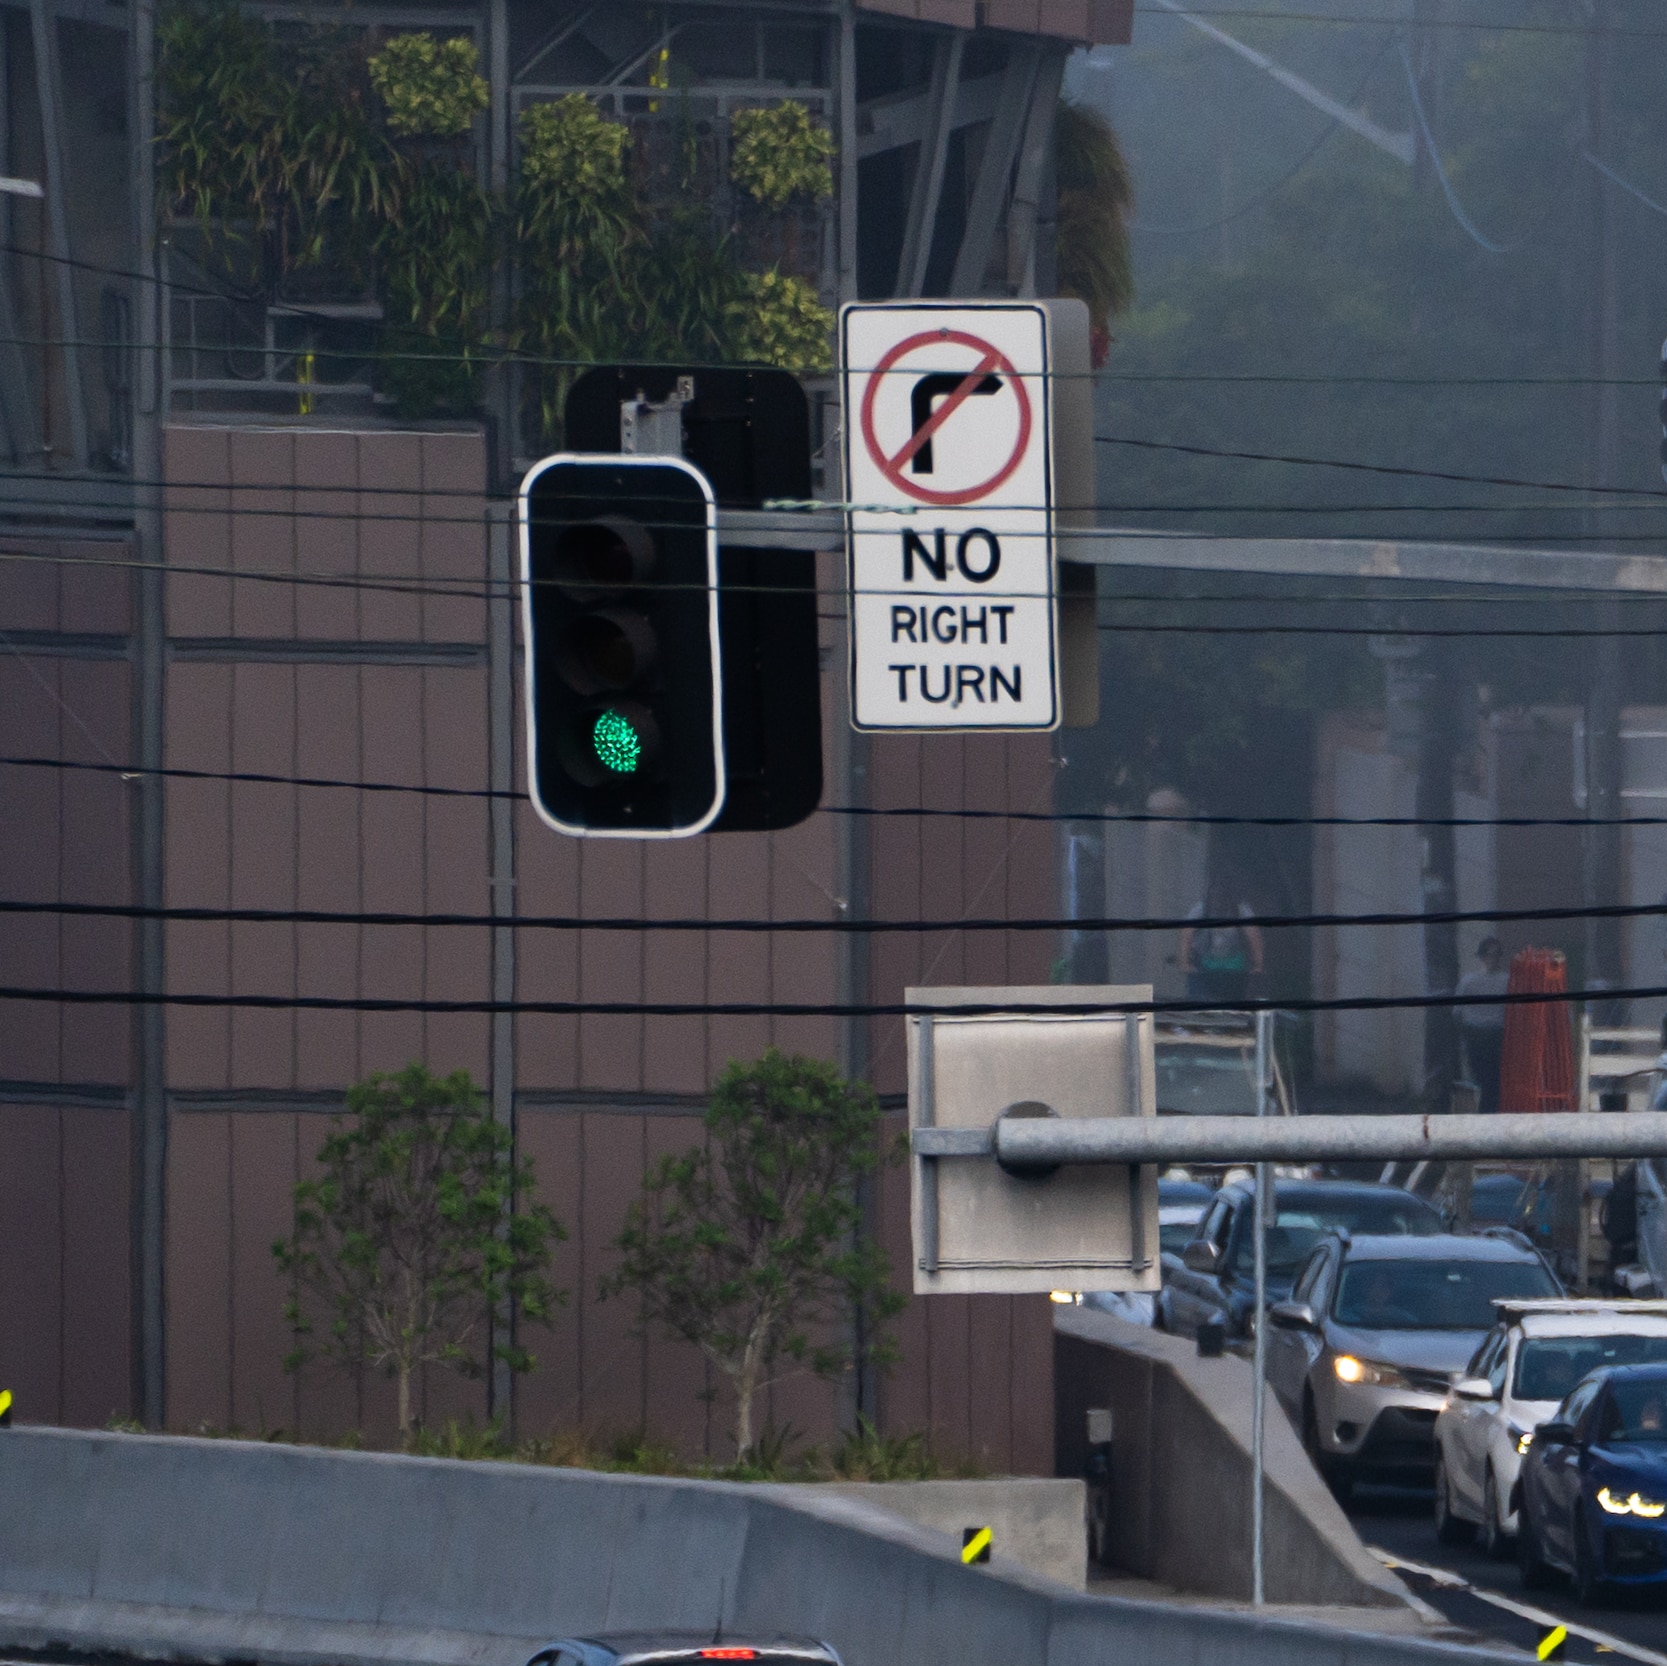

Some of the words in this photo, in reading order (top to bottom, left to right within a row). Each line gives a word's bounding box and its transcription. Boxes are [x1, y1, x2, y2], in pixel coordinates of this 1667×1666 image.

[902, 527, 1002, 584] NO
[890, 605, 1014, 645] RIGHT
[888, 664, 1022, 704] TURN
